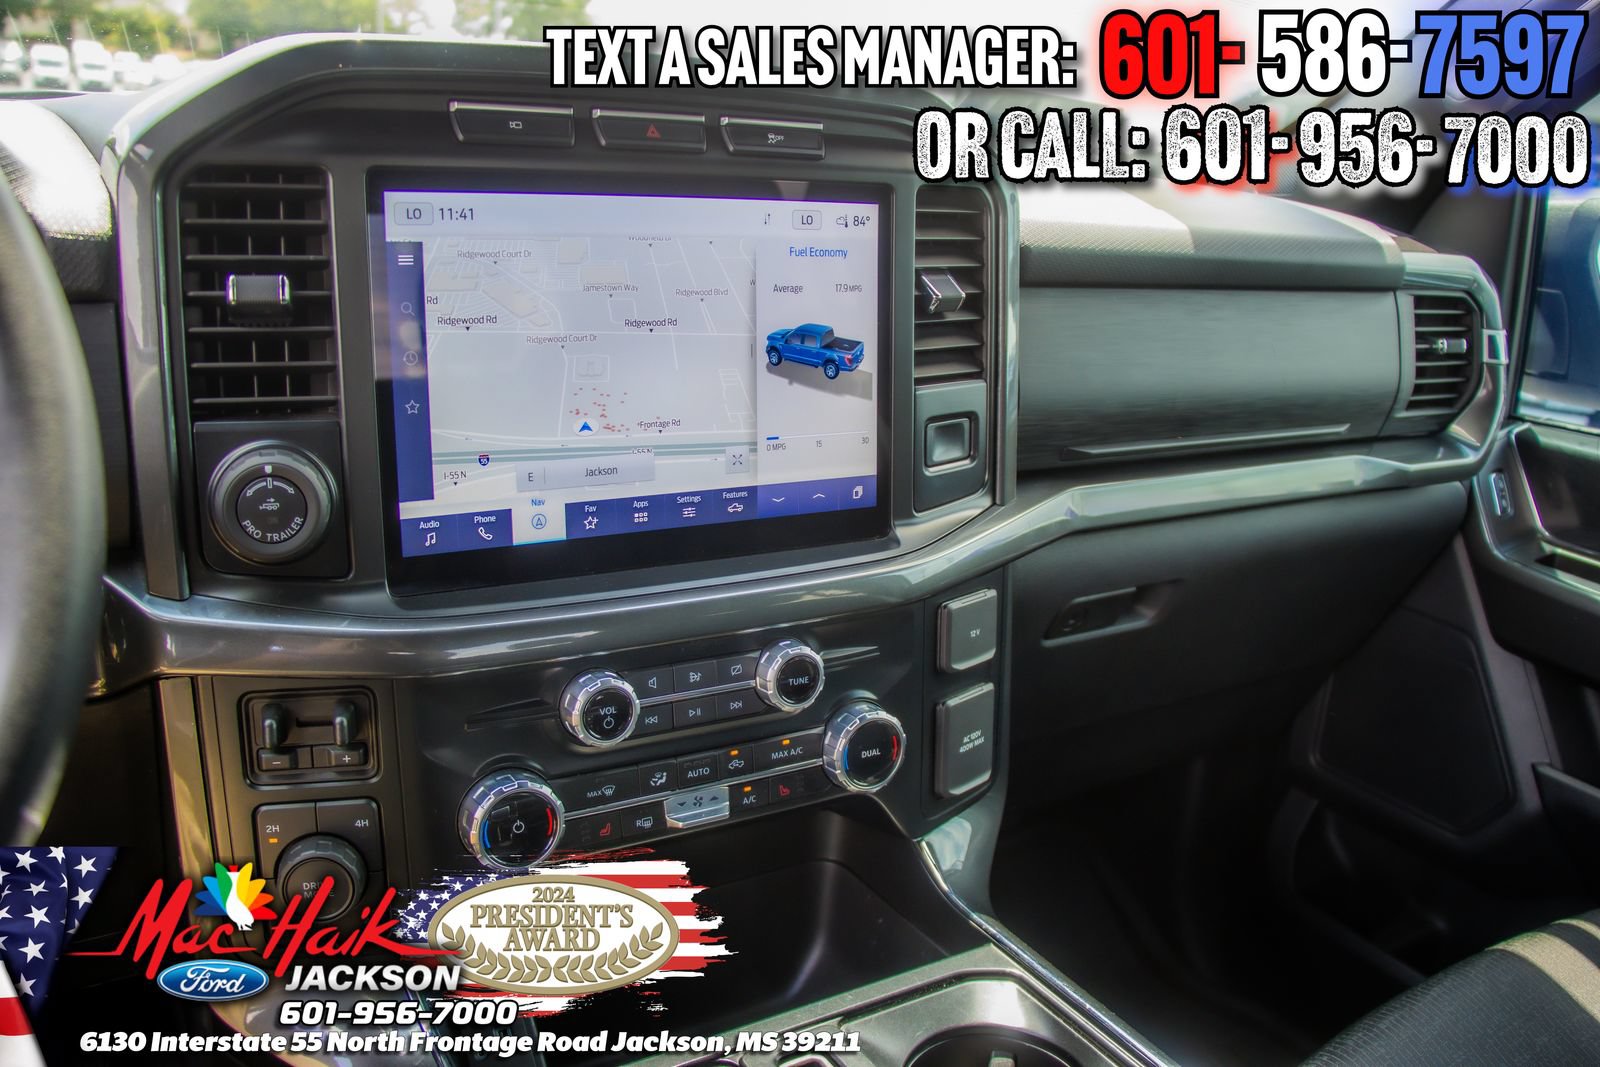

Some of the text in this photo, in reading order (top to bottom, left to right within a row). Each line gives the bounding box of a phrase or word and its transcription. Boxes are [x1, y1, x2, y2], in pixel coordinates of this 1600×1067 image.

[406, 207, 422, 220] LO
[439, 207, 475, 221] 11:41
[801, 215, 814, 225] LO
[853, 216, 871, 227] 84°
[457, 250, 532, 261] Ridgewood Court Dr
[789, 246, 848, 259] Fuel Economy
[582, 284, 639, 293] Jamestown Way
[675, 287, 729, 297] Ridgewood Blvd
[773, 284, 803, 294] Average
[835, 284, 849, 293] 17.9
[426, 296, 438, 305] Rd
[437, 315, 498, 327] Ridgewood Rd
[624, 318, 678, 328] Ridgewood Rd
[526, 334, 598, 344] Ridgewood Court Dr
[640, 418, 681, 430] Frontage Rd
[815, 440, 823, 448] 15
[861, 436, 870, 444] 30
[772, 443, 787, 451] MPG
[444, 470, 467, 480] I-55 N
[584, 465, 618, 477] Jackson
[527, 473, 534, 482] E
[676, 494, 702, 504] Settings
[722, 490, 748, 499] Features
[531, 498, 546, 507] Nav
[633, 500, 649, 509] Apps
[584, 504, 597, 513] Fav
[419, 520, 440, 529] Audio
[474, 515, 496, 524] Phone
[241, 516, 304, 542] PRO TRAILER
[788, 676, 809, 686] TUNE
[599, 706, 617, 715] VOL
[963, 735, 970, 743] AC
[960, 736, 985, 753] 400W MAX
[771, 746, 804, 760] MAX A/C
[861, 748, 881, 758] DUAL
[687, 767, 710, 779] AUTO
[586, 790, 602, 798] MAX
[743, 794, 757, 804] A/C
[265, 824, 280, 833] 2H
[354, 819, 369, 828] 4H
